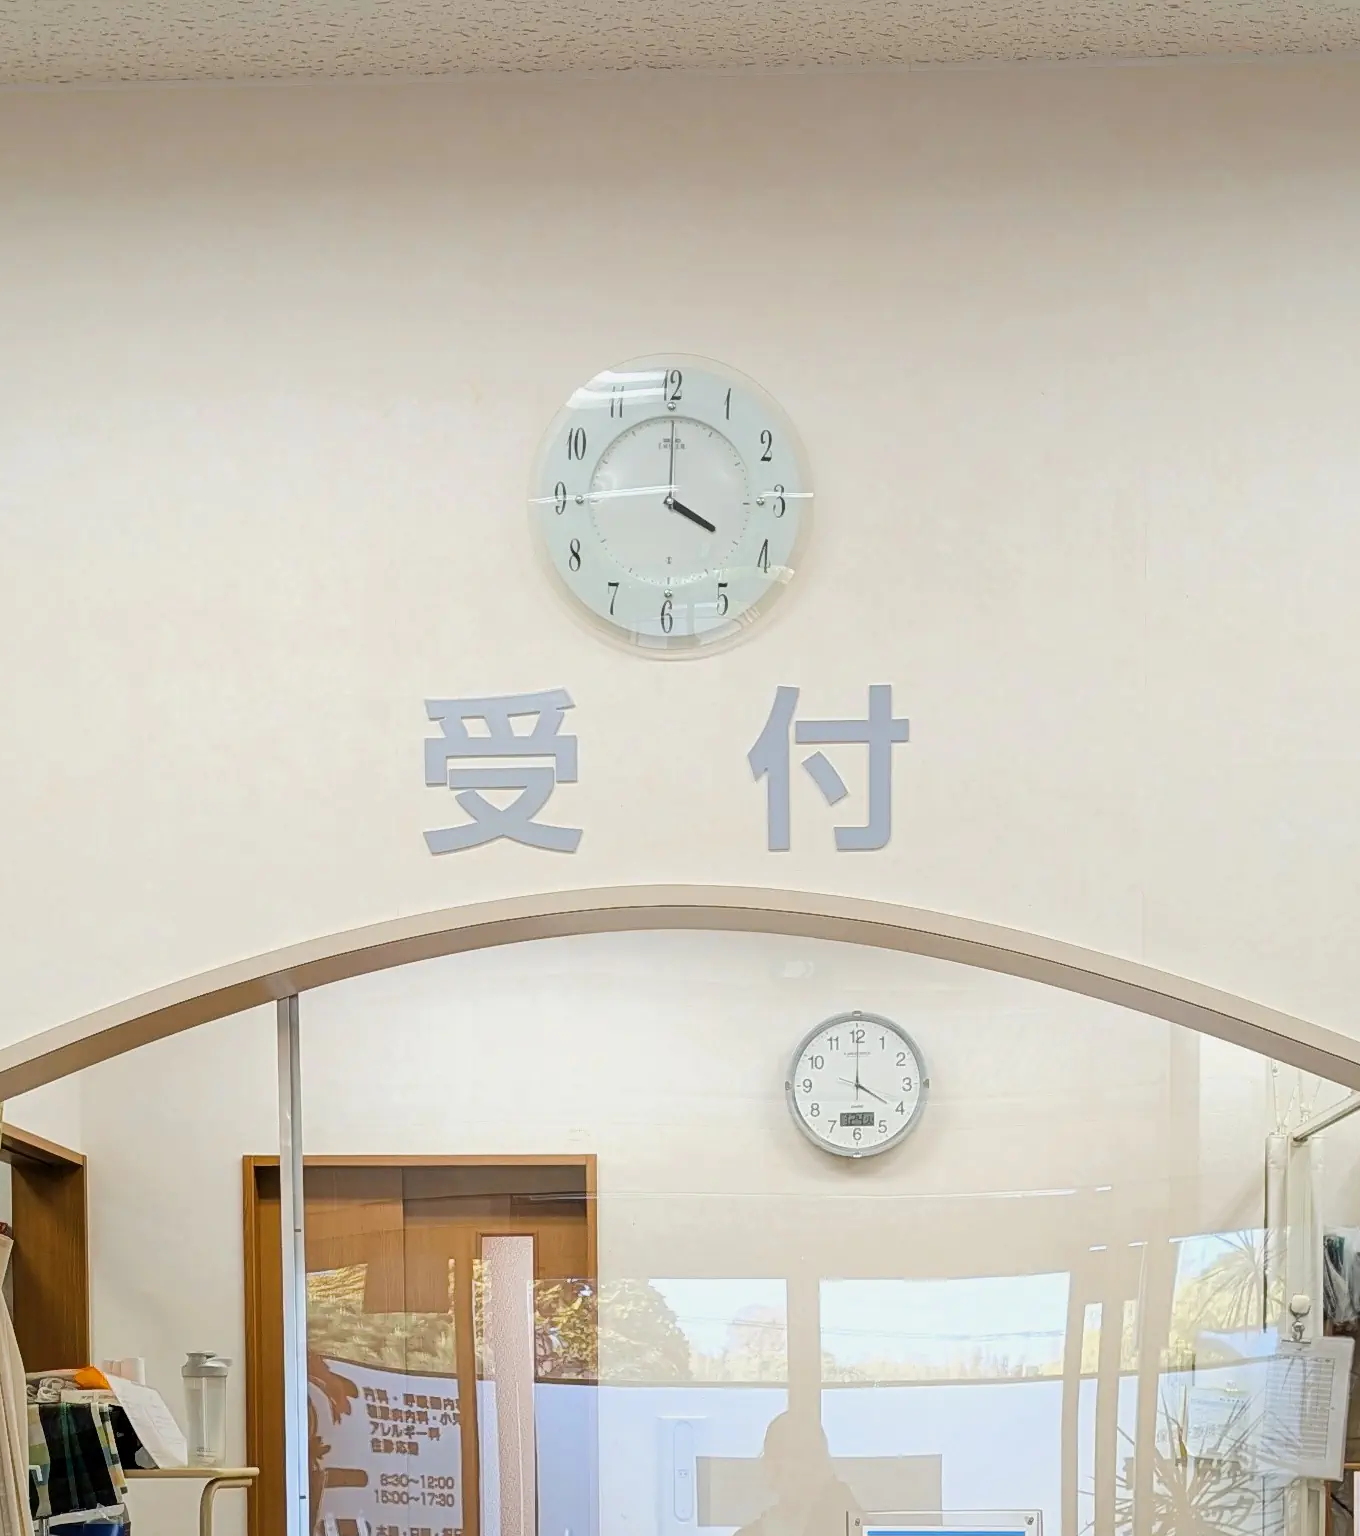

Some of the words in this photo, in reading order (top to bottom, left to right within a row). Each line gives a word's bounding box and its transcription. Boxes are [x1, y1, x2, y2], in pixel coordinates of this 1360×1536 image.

[661, 370, 682, 401] 12
[609, 386, 624, 418] 11
[724, 387, 731, 420] 1
[566, 427, 586, 460] 10
[760, 429, 773, 462] 2
[554, 481, 567, 515] 9
[773, 484, 786, 518] 3
[568, 538, 581, 572] 8
[757, 539, 771, 573] 4
[607, 582, 619, 616] 7
[716, 582, 728, 616] 5
[660, 600, 673, 634] 6
[423, 684, 909, 855] 受付
[827, 1036, 839, 1050] 11
[850, 1029, 865, 1043] 12
[879, 1036, 884, 1049] 1
[808, 1055, 824, 1069] 10
[896, 1052, 905, 1066] 2
[802, 1078, 812, 1093] 9
[902, 1077, 912, 1092] 3
[810, 1103, 820, 1117] 8
[895, 1101, 905, 1115] 4
[828, 1120, 837, 1132] 7
[853, 1128, 861, 1140] 6
[878, 1120, 887, 1134] 5
